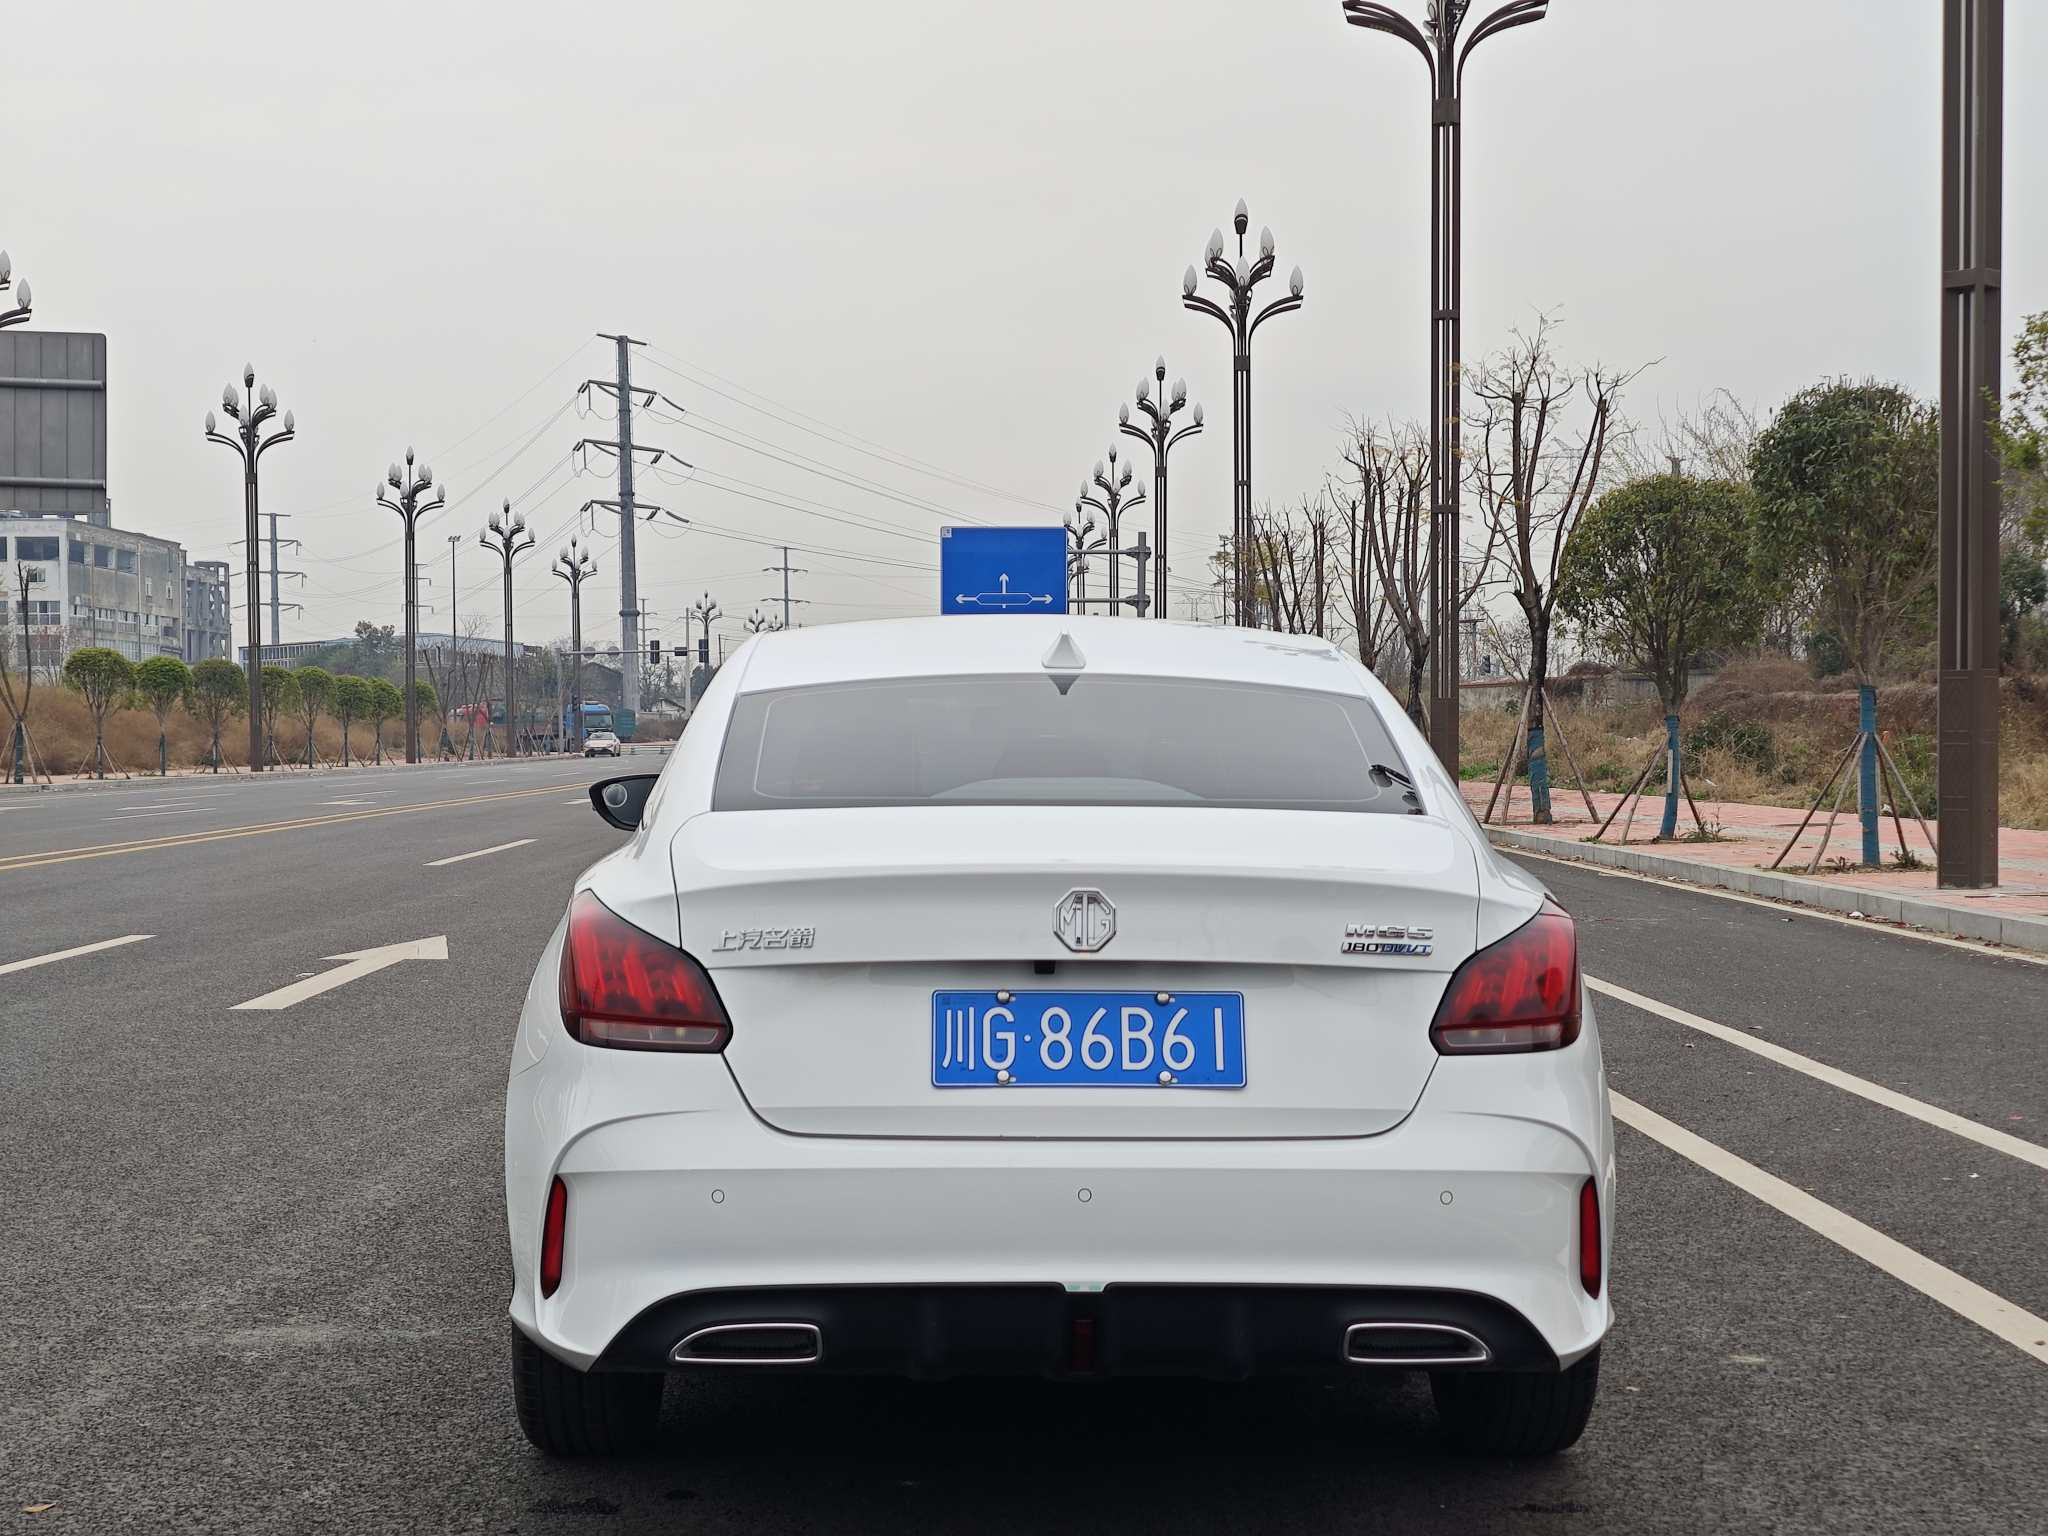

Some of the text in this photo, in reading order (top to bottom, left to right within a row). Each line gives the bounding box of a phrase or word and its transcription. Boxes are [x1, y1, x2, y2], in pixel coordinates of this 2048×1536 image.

[1057, 892, 1113, 948] MG
[1345, 923, 1433, 940] MG5
[712, 927, 816, 953] 上汽名爵
